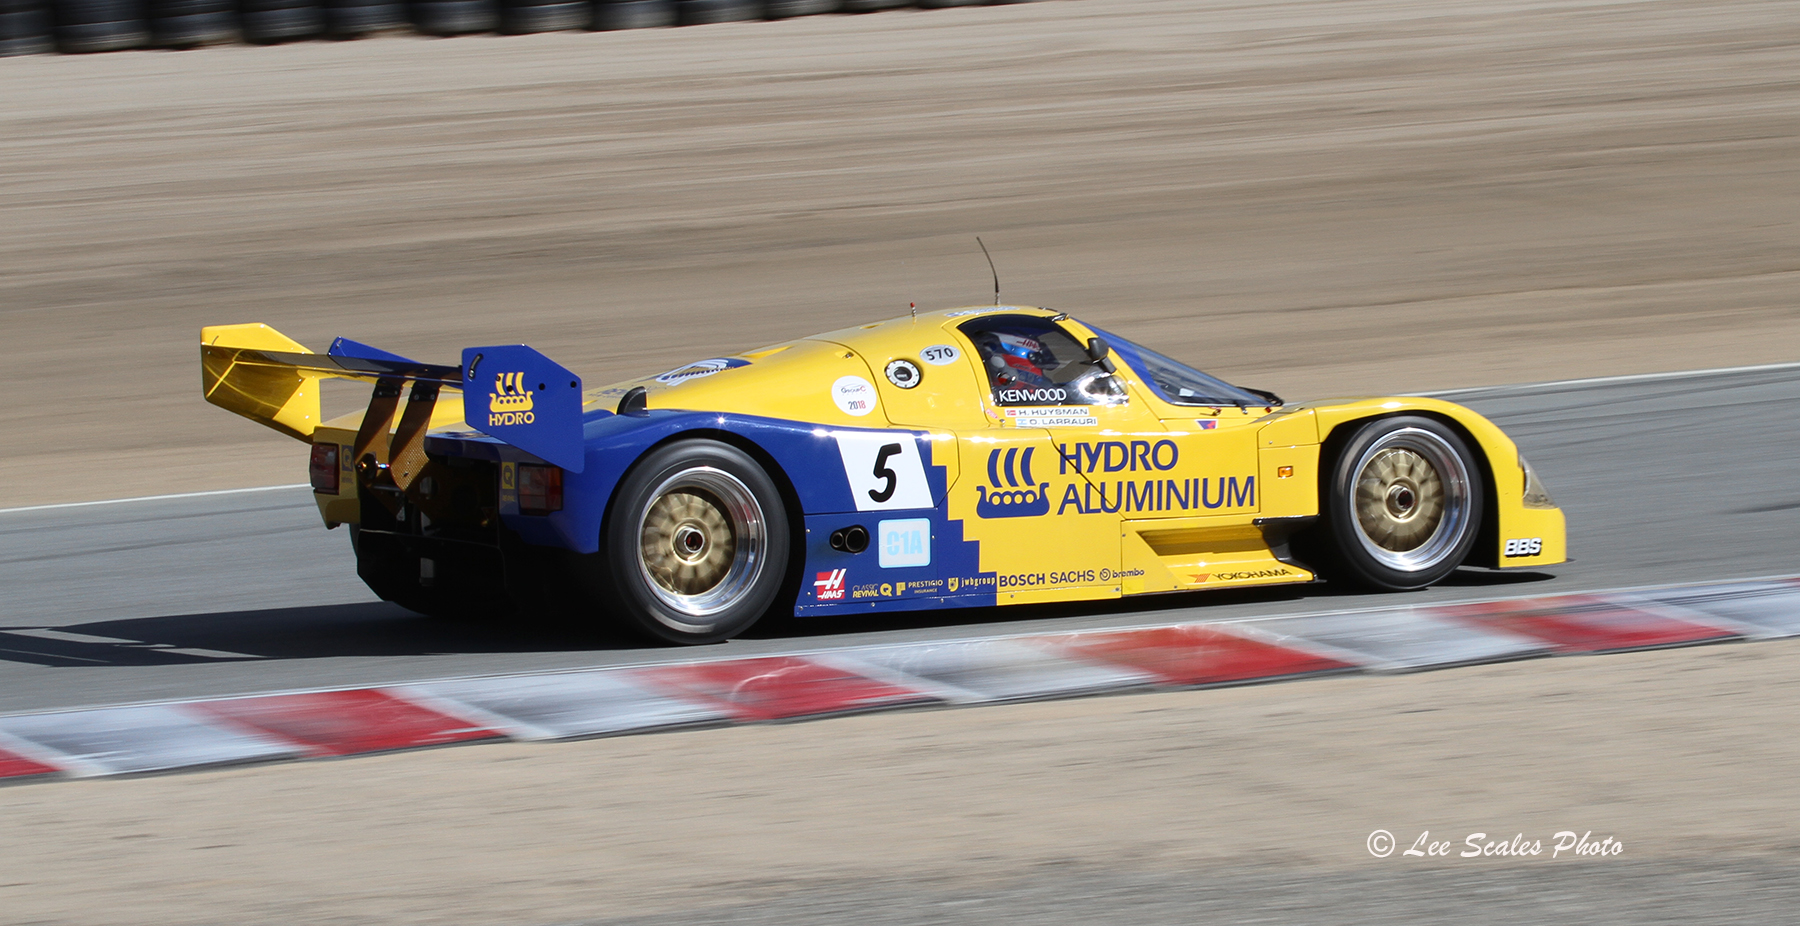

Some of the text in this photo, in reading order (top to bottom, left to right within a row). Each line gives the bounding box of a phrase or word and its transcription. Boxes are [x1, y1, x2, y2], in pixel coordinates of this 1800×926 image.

[926, 347, 953, 360] 570
[998, 388, 1067, 402] KENWOOD
[848, 400, 866, 410] 2018
[489, 411, 535, 426] HYDRO
[1042, 418, 1096, 426] LARRAURI
[1059, 440, 1179, 475] HYDRO
[868, 443, 902, 503] 5
[1057, 476, 1255, 515] ALUMINIUM
[886, 530, 923, 556] C1A
[1504, 537, 1542, 558] BBS
[1050, 570, 1095, 584] SACHS
[1112, 568, 1145, 578] brembo
[1213, 568, 1293, 580] YOKOHAMA
[908, 579, 943, 588] PRESTIGIO
[961, 577, 996, 588] jwbgroup
[999, 573, 1045, 587] BOSCH
[852, 583, 879, 591] CLASSIC
[852, 589, 879, 598] REVIVAL
[817, 590, 845, 599] HAAS
